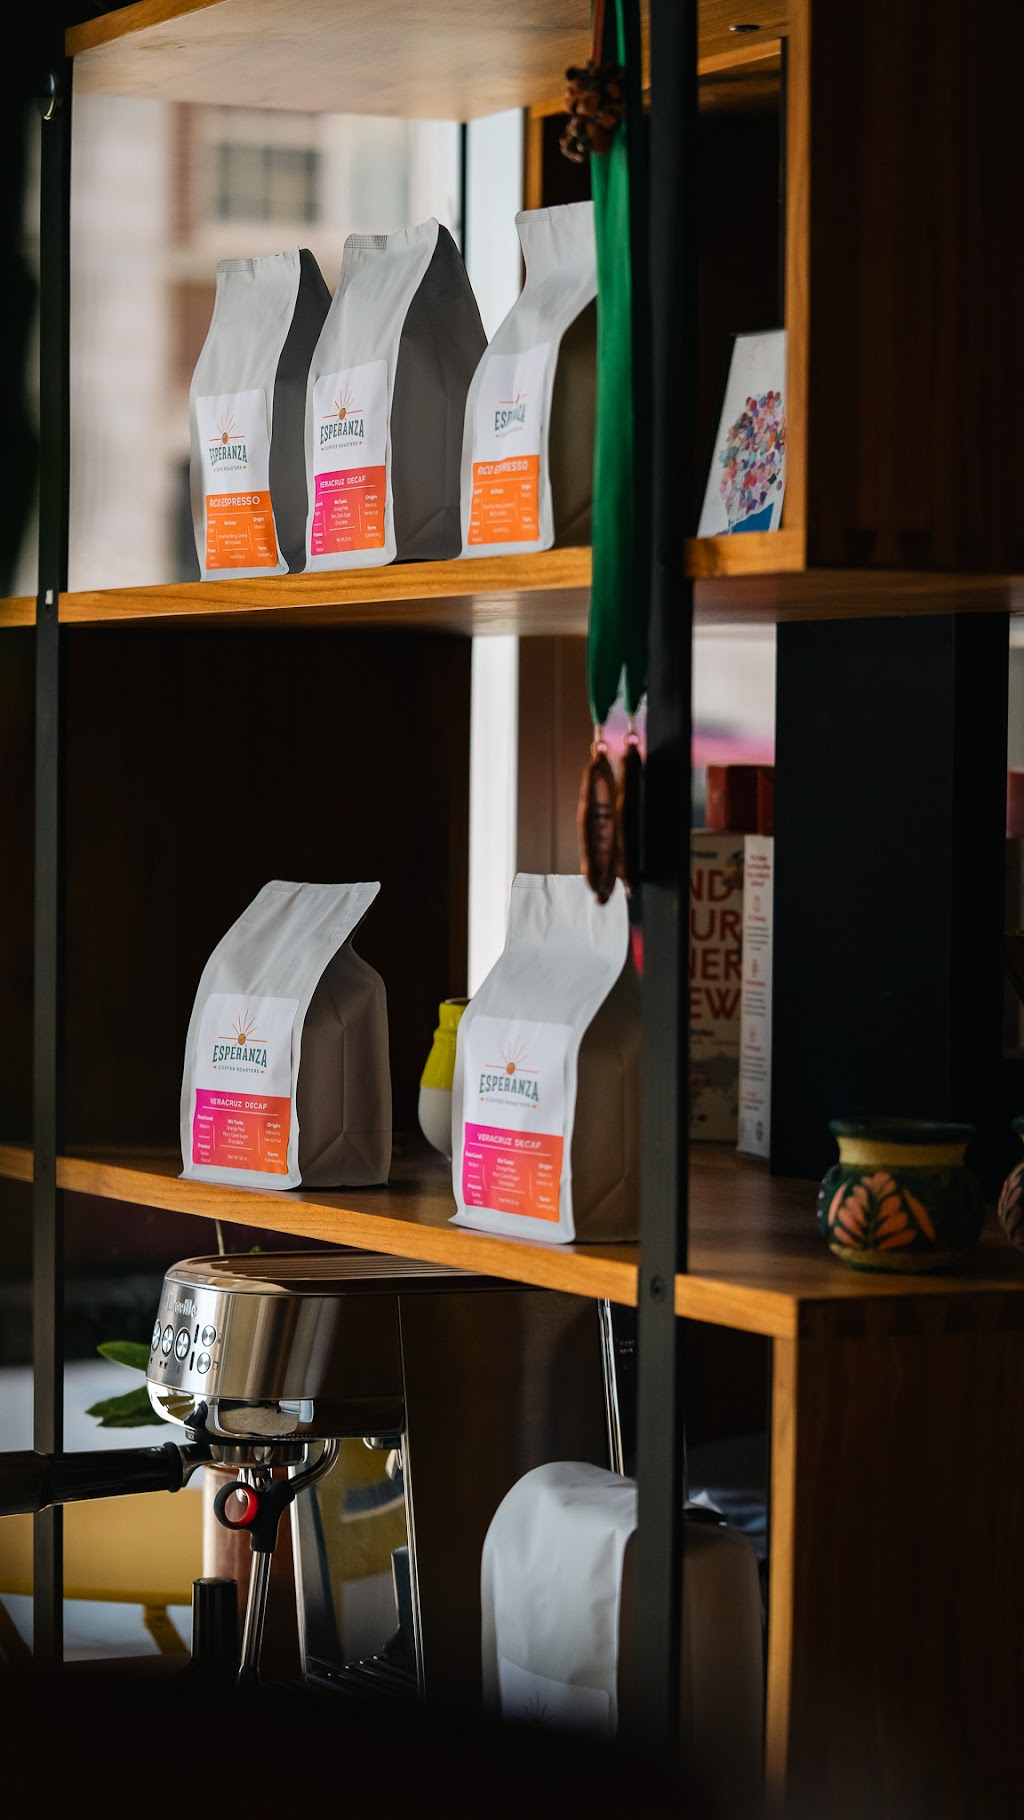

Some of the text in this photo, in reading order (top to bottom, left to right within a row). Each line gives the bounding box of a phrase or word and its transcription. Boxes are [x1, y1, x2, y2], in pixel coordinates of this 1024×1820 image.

[320, 419, 364, 445] ESPERANZA
[209, 445, 247, 466] ESPERANZA
[347, 475, 366, 484] DECAF
[209, 496, 260, 508] RICO ESPRESSO
[212, 1045, 267, 1068] ESPERANZA
[479, 1074, 538, 1102] ESPERANZA
[209, 1097, 267, 1110] VERACRUZ DECAF
[477, 1133, 541, 1149] VERACRUZ DECAF
